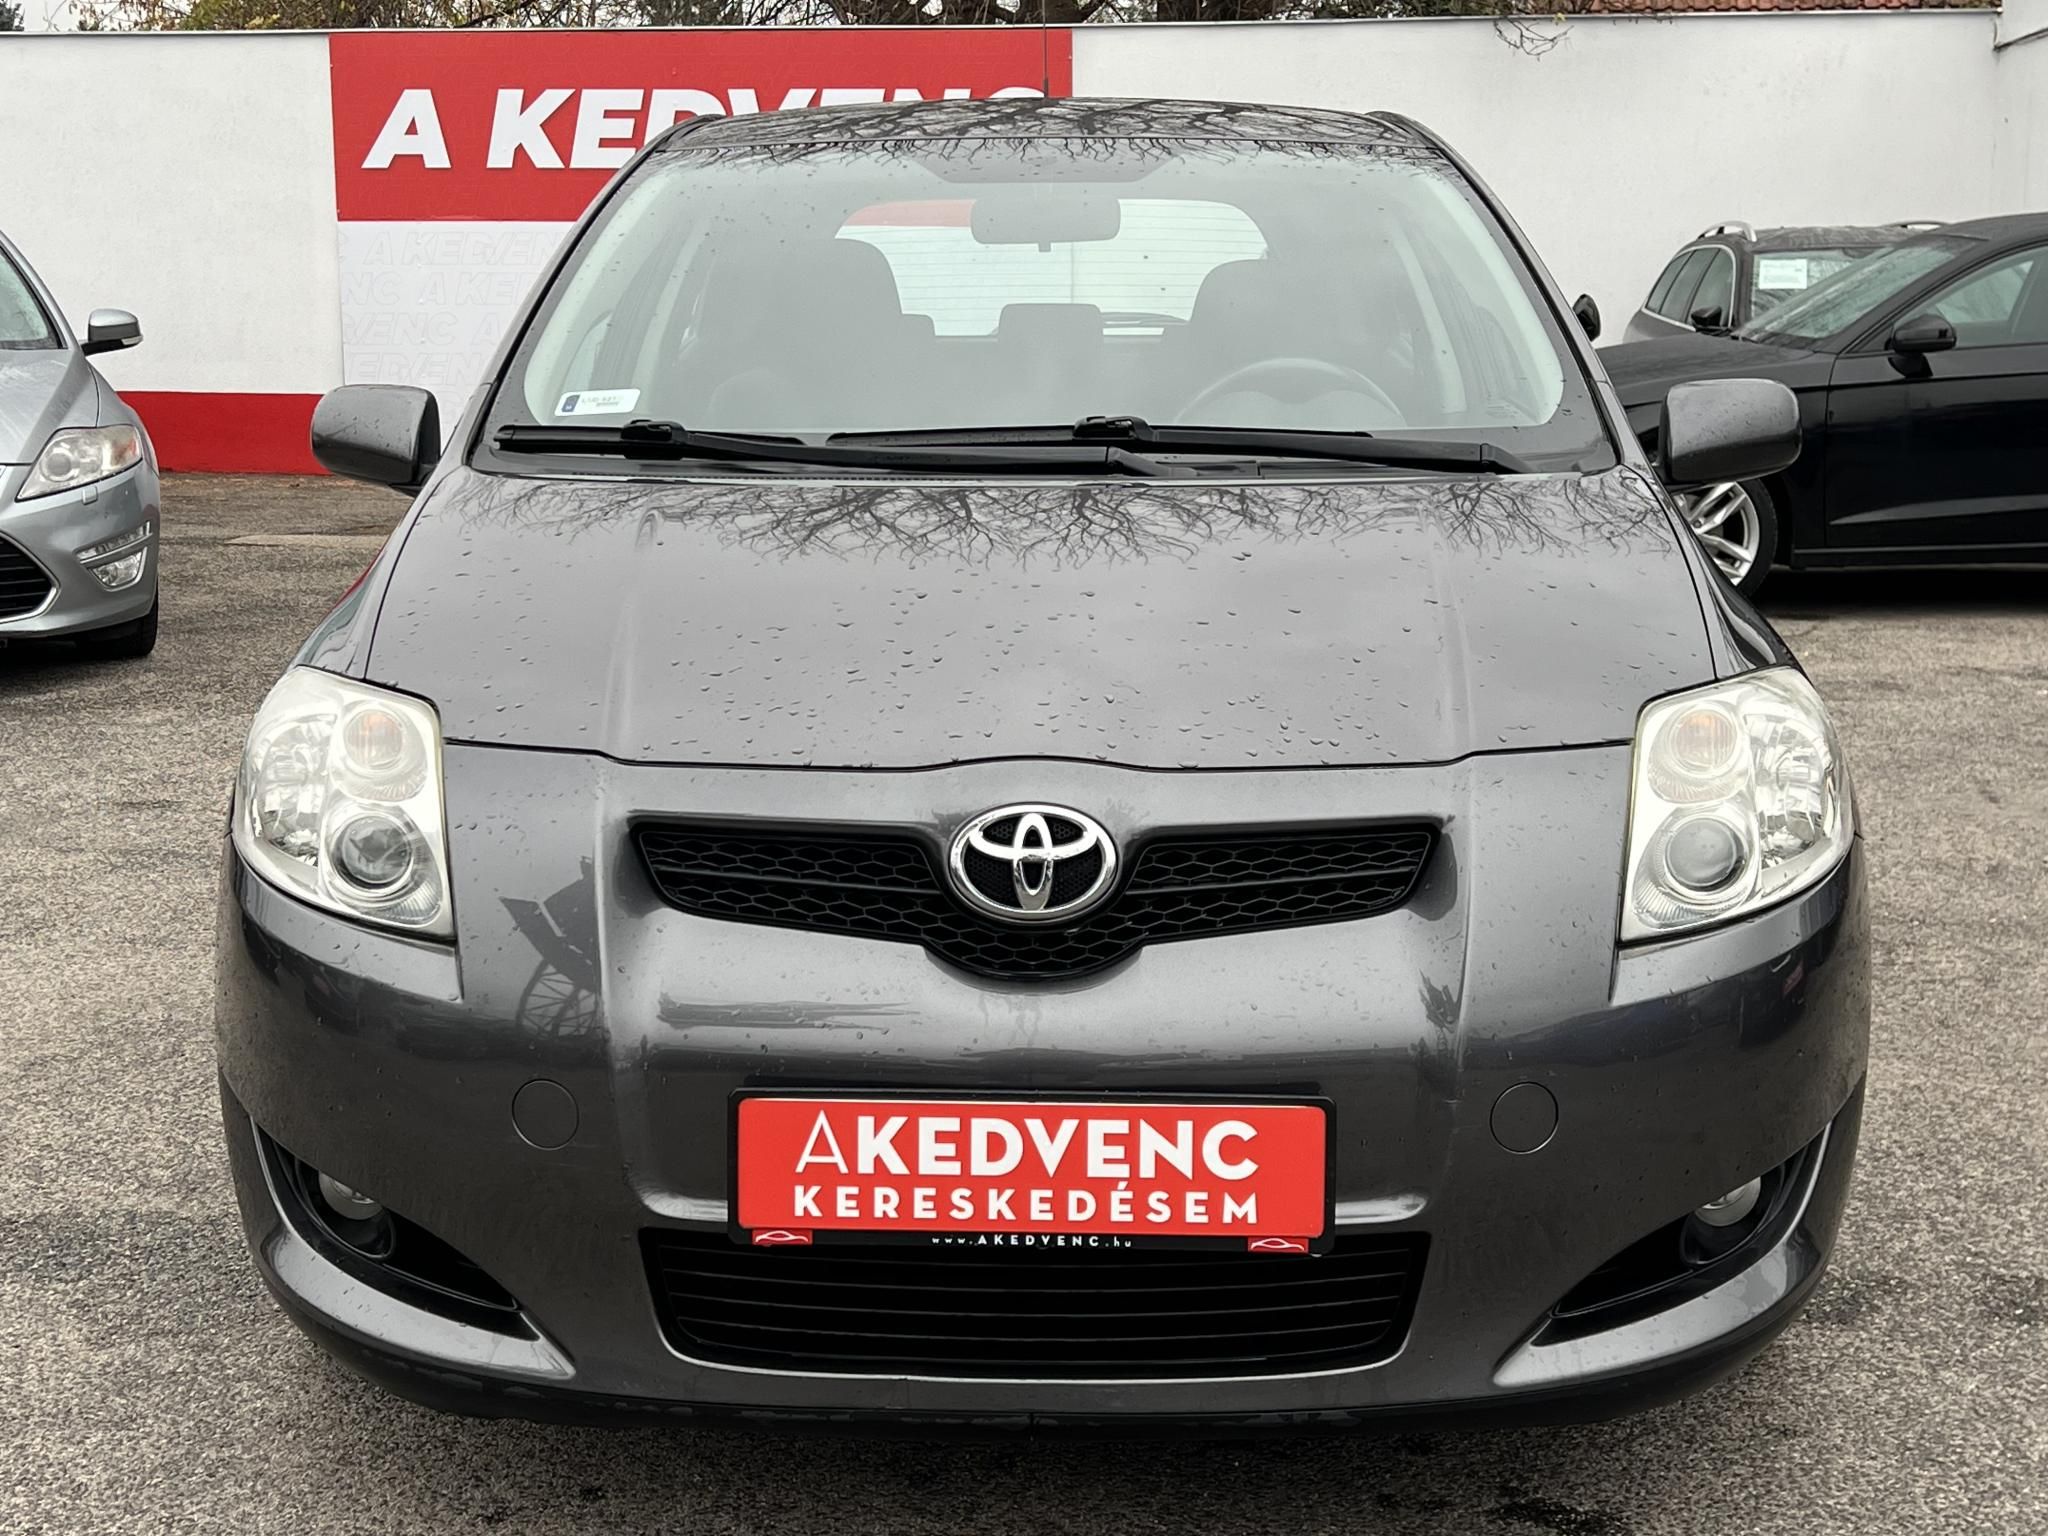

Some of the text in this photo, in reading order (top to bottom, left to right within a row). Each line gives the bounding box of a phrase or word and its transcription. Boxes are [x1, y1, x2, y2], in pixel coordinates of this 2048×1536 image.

[361, 88, 452, 169] A
[795, 1182, 1258, 1224] KERESKEDÉSEM
[932, 1234, 1132, 1248] www.AKEDVENC.hu
